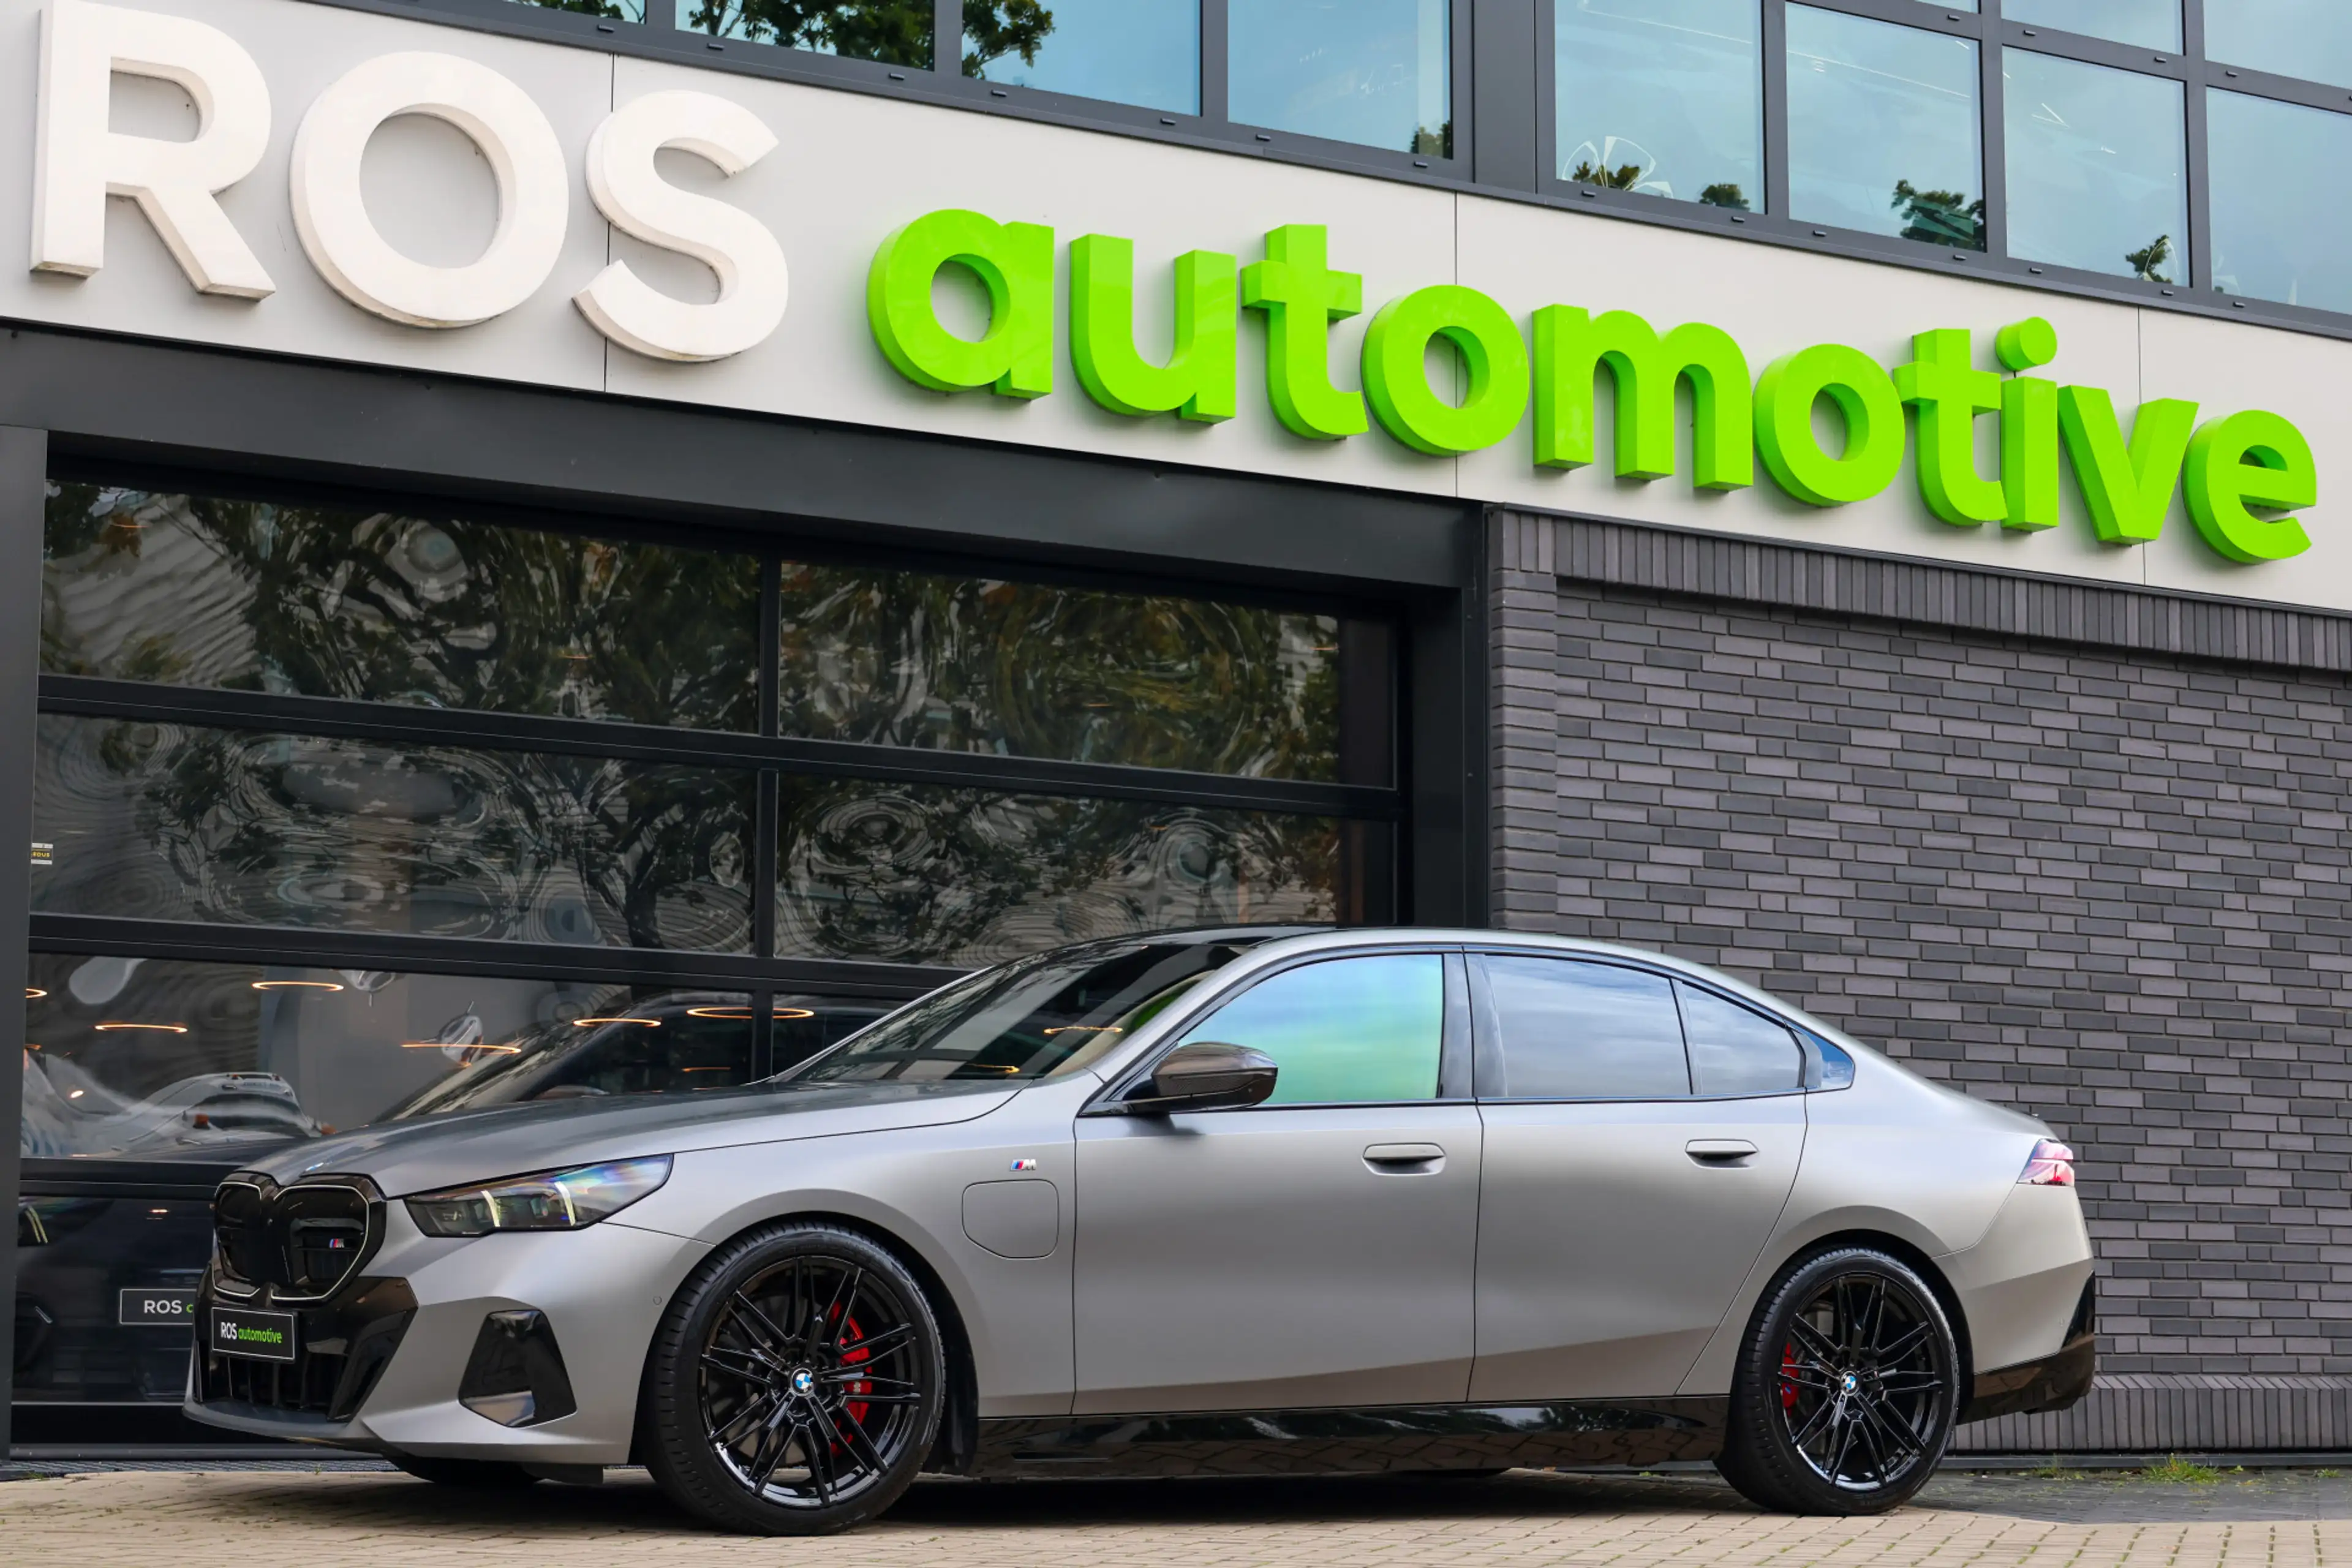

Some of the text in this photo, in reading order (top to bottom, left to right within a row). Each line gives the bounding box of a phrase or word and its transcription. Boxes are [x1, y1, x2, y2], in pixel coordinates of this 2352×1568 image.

[30, 0, 2317, 564] ROS automotive
[143, 1299, 183, 1314] ROS
[221, 1322, 282, 1344] ROS automotive
